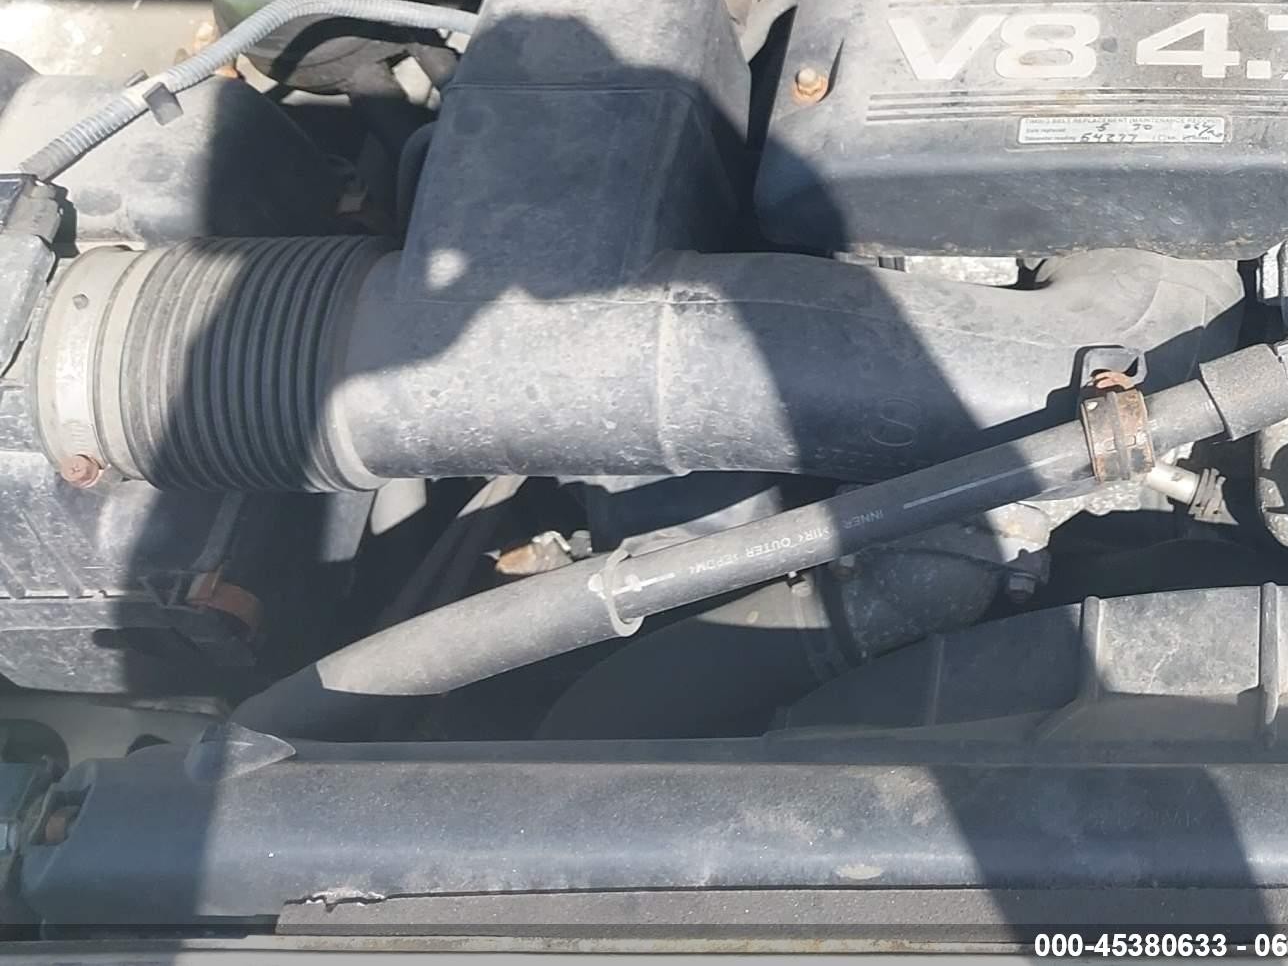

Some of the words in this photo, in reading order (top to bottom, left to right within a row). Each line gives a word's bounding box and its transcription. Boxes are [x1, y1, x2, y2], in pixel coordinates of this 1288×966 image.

[888, 13, 1099, 80] V8
[843, 510, 883, 529] INNER
[745, 536, 791, 558] OUTER
